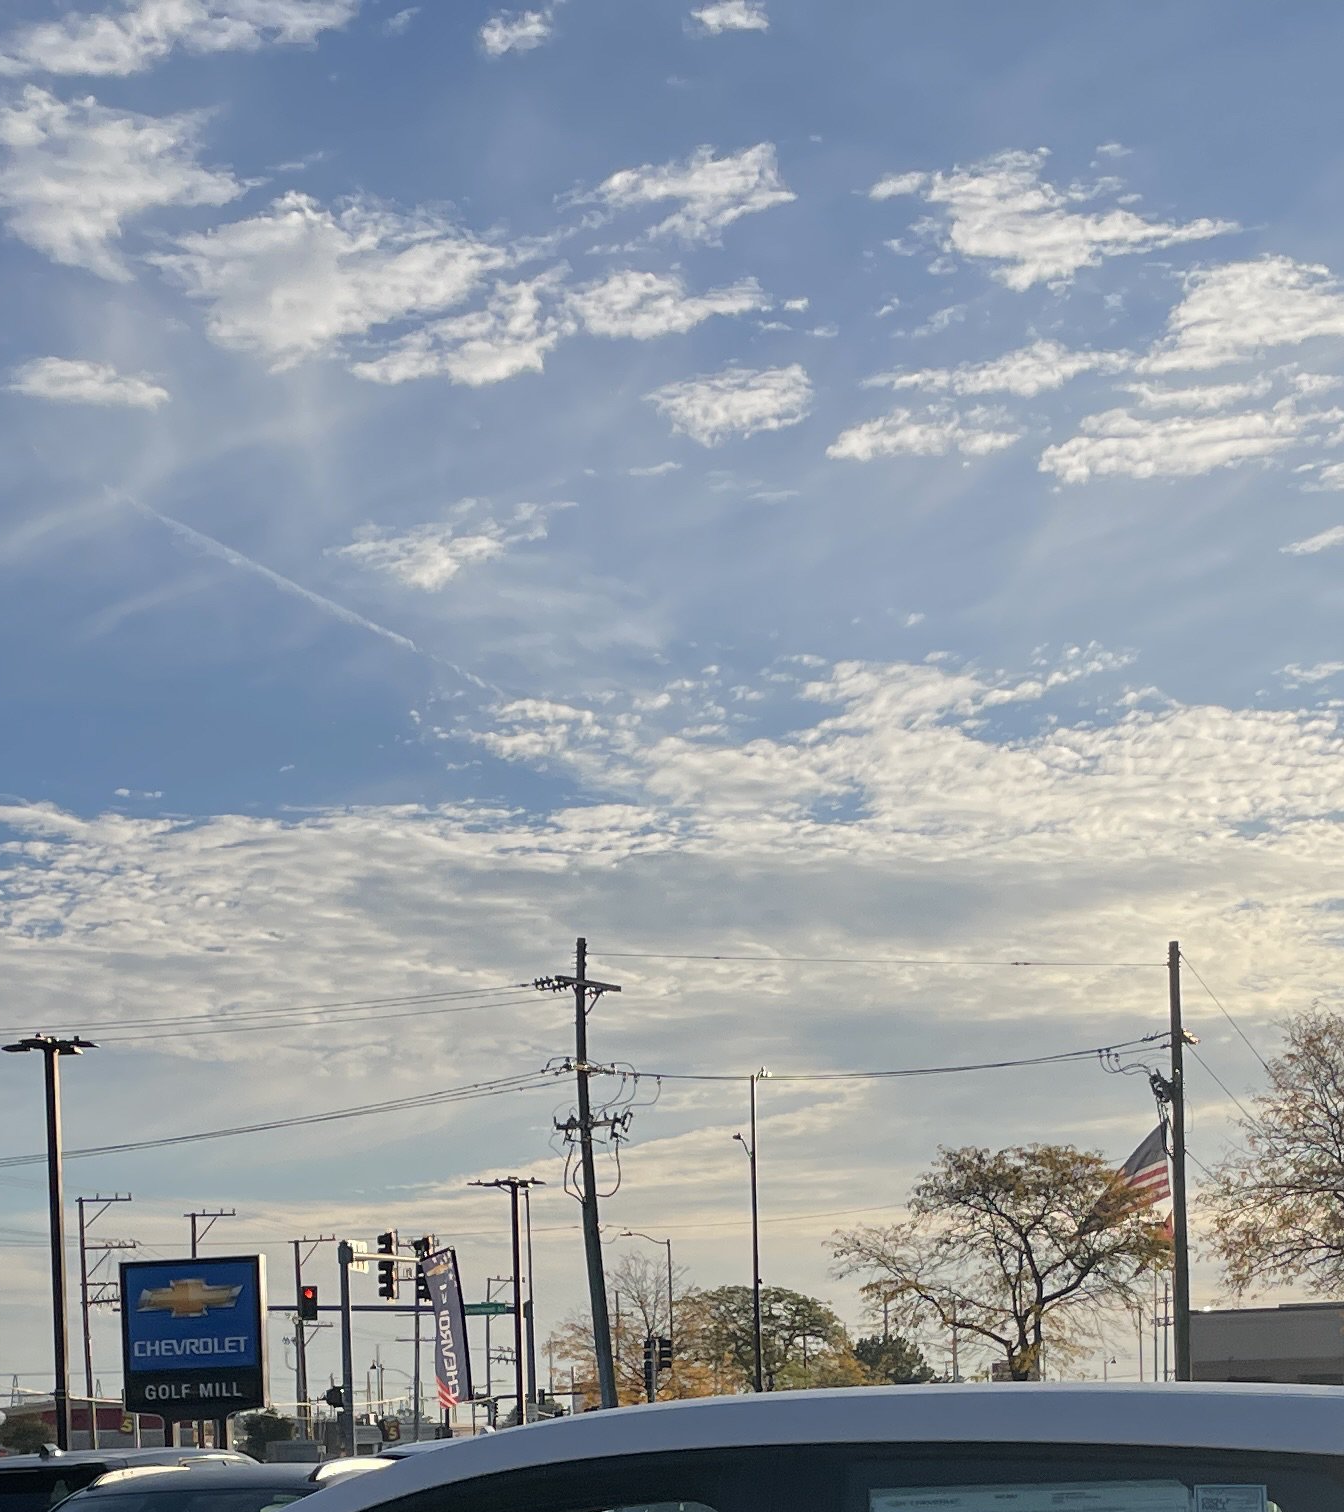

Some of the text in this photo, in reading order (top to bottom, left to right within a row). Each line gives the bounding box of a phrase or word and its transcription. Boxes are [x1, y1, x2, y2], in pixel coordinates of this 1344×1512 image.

[134, 1336, 248, 1357] CHEVROLET
[145, 1381, 243, 1400] GOLF MILL
